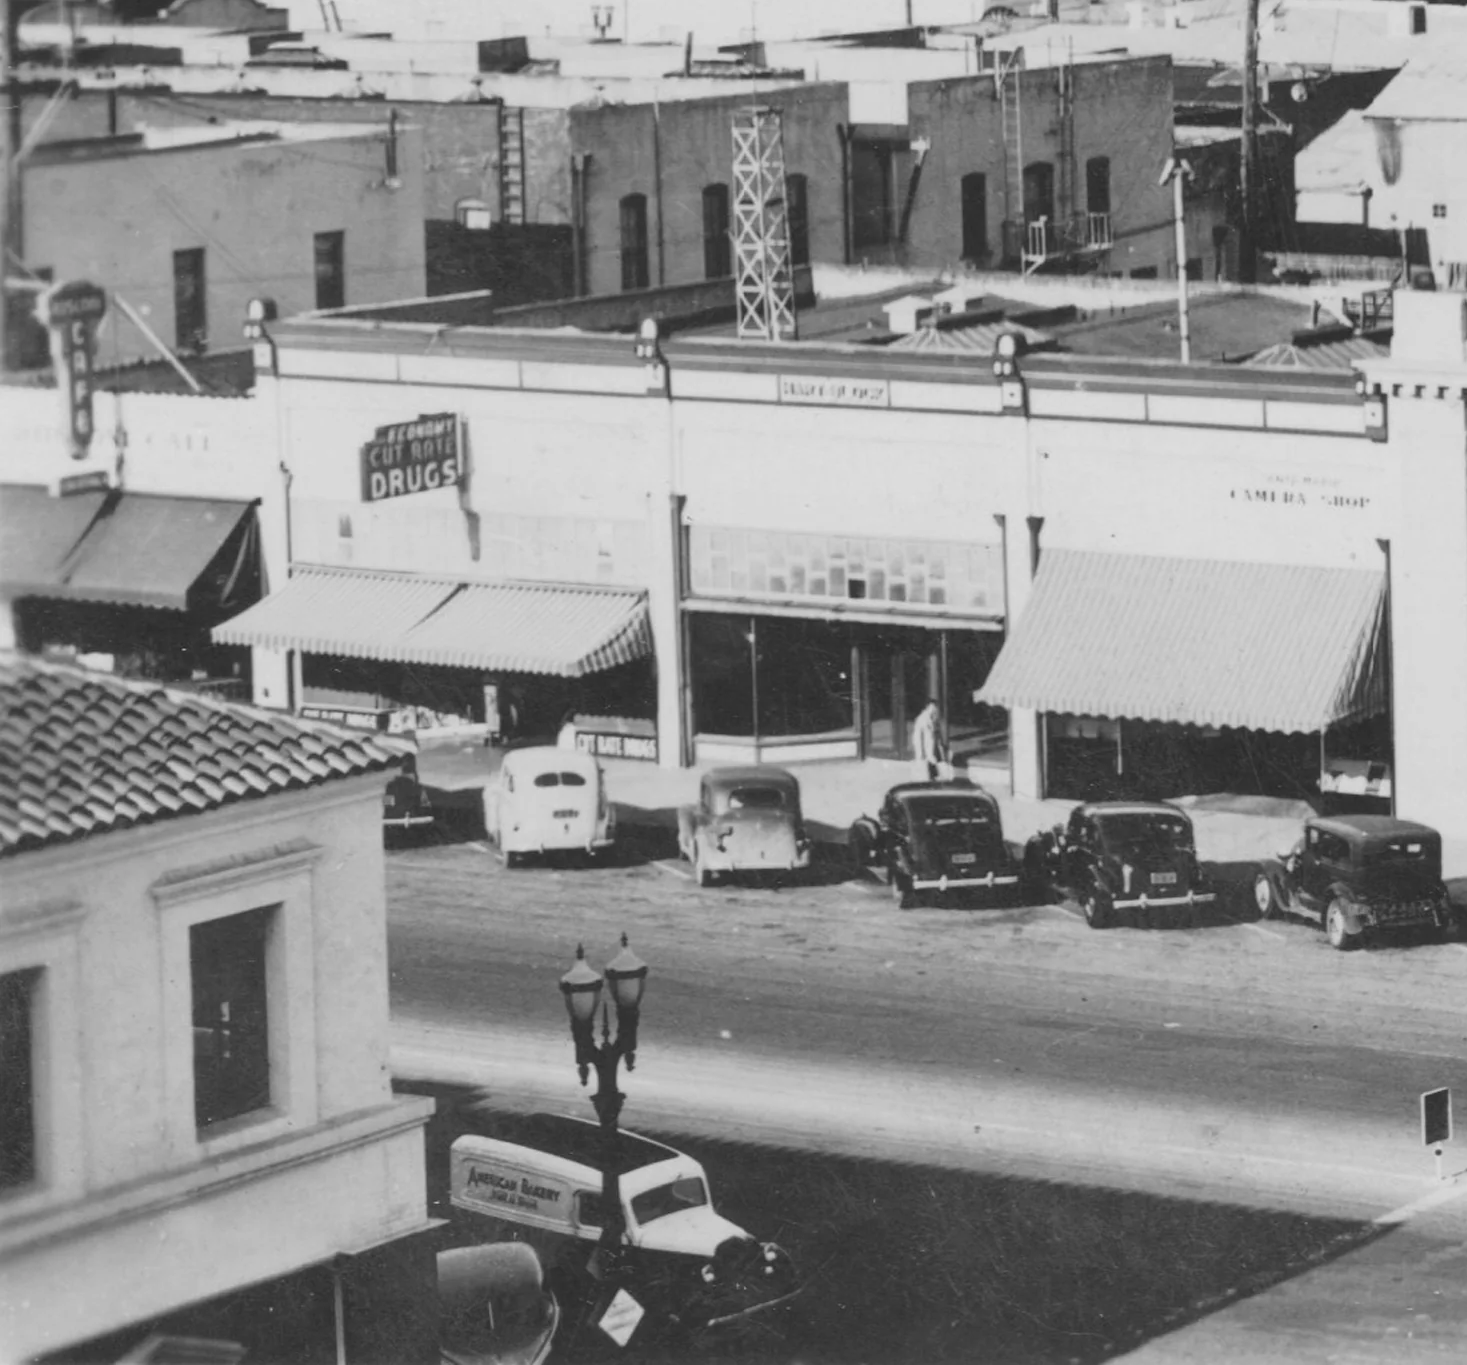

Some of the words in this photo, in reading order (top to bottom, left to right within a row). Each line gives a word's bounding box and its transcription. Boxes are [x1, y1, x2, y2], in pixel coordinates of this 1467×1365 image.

[369, 442, 402, 468] CUT
[410, 436, 454, 462] RATE
[370, 458, 457, 500] DRUGS
